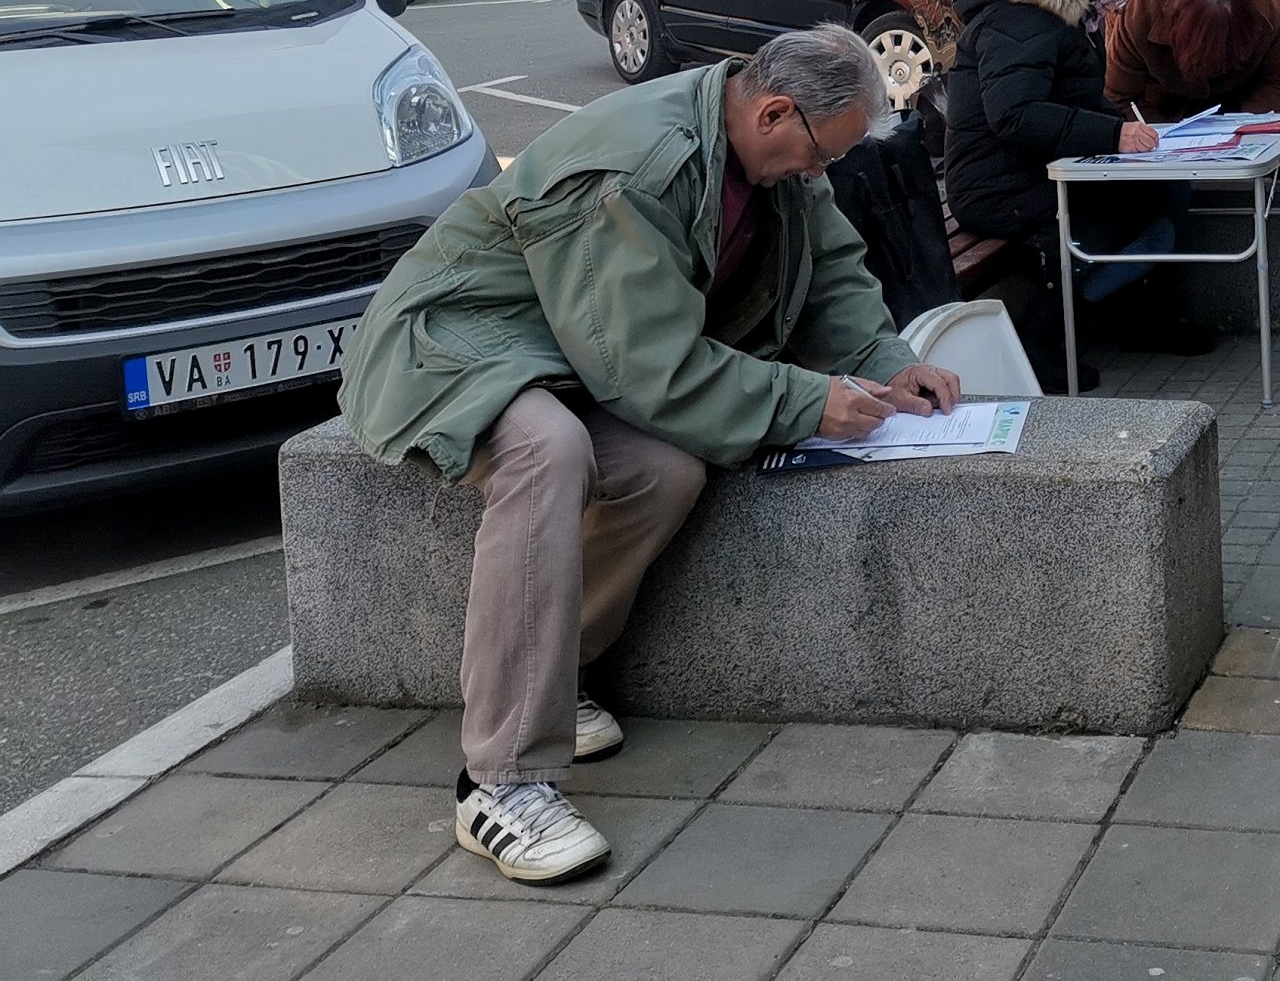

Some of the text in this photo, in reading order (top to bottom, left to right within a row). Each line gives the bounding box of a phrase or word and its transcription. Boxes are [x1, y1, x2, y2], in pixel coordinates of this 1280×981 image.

[151, 140, 225, 187] FIAT
[155, 354, 207, 396] VA
[217, 375, 231, 387] BA
[127, 390, 147, 403] SRB
